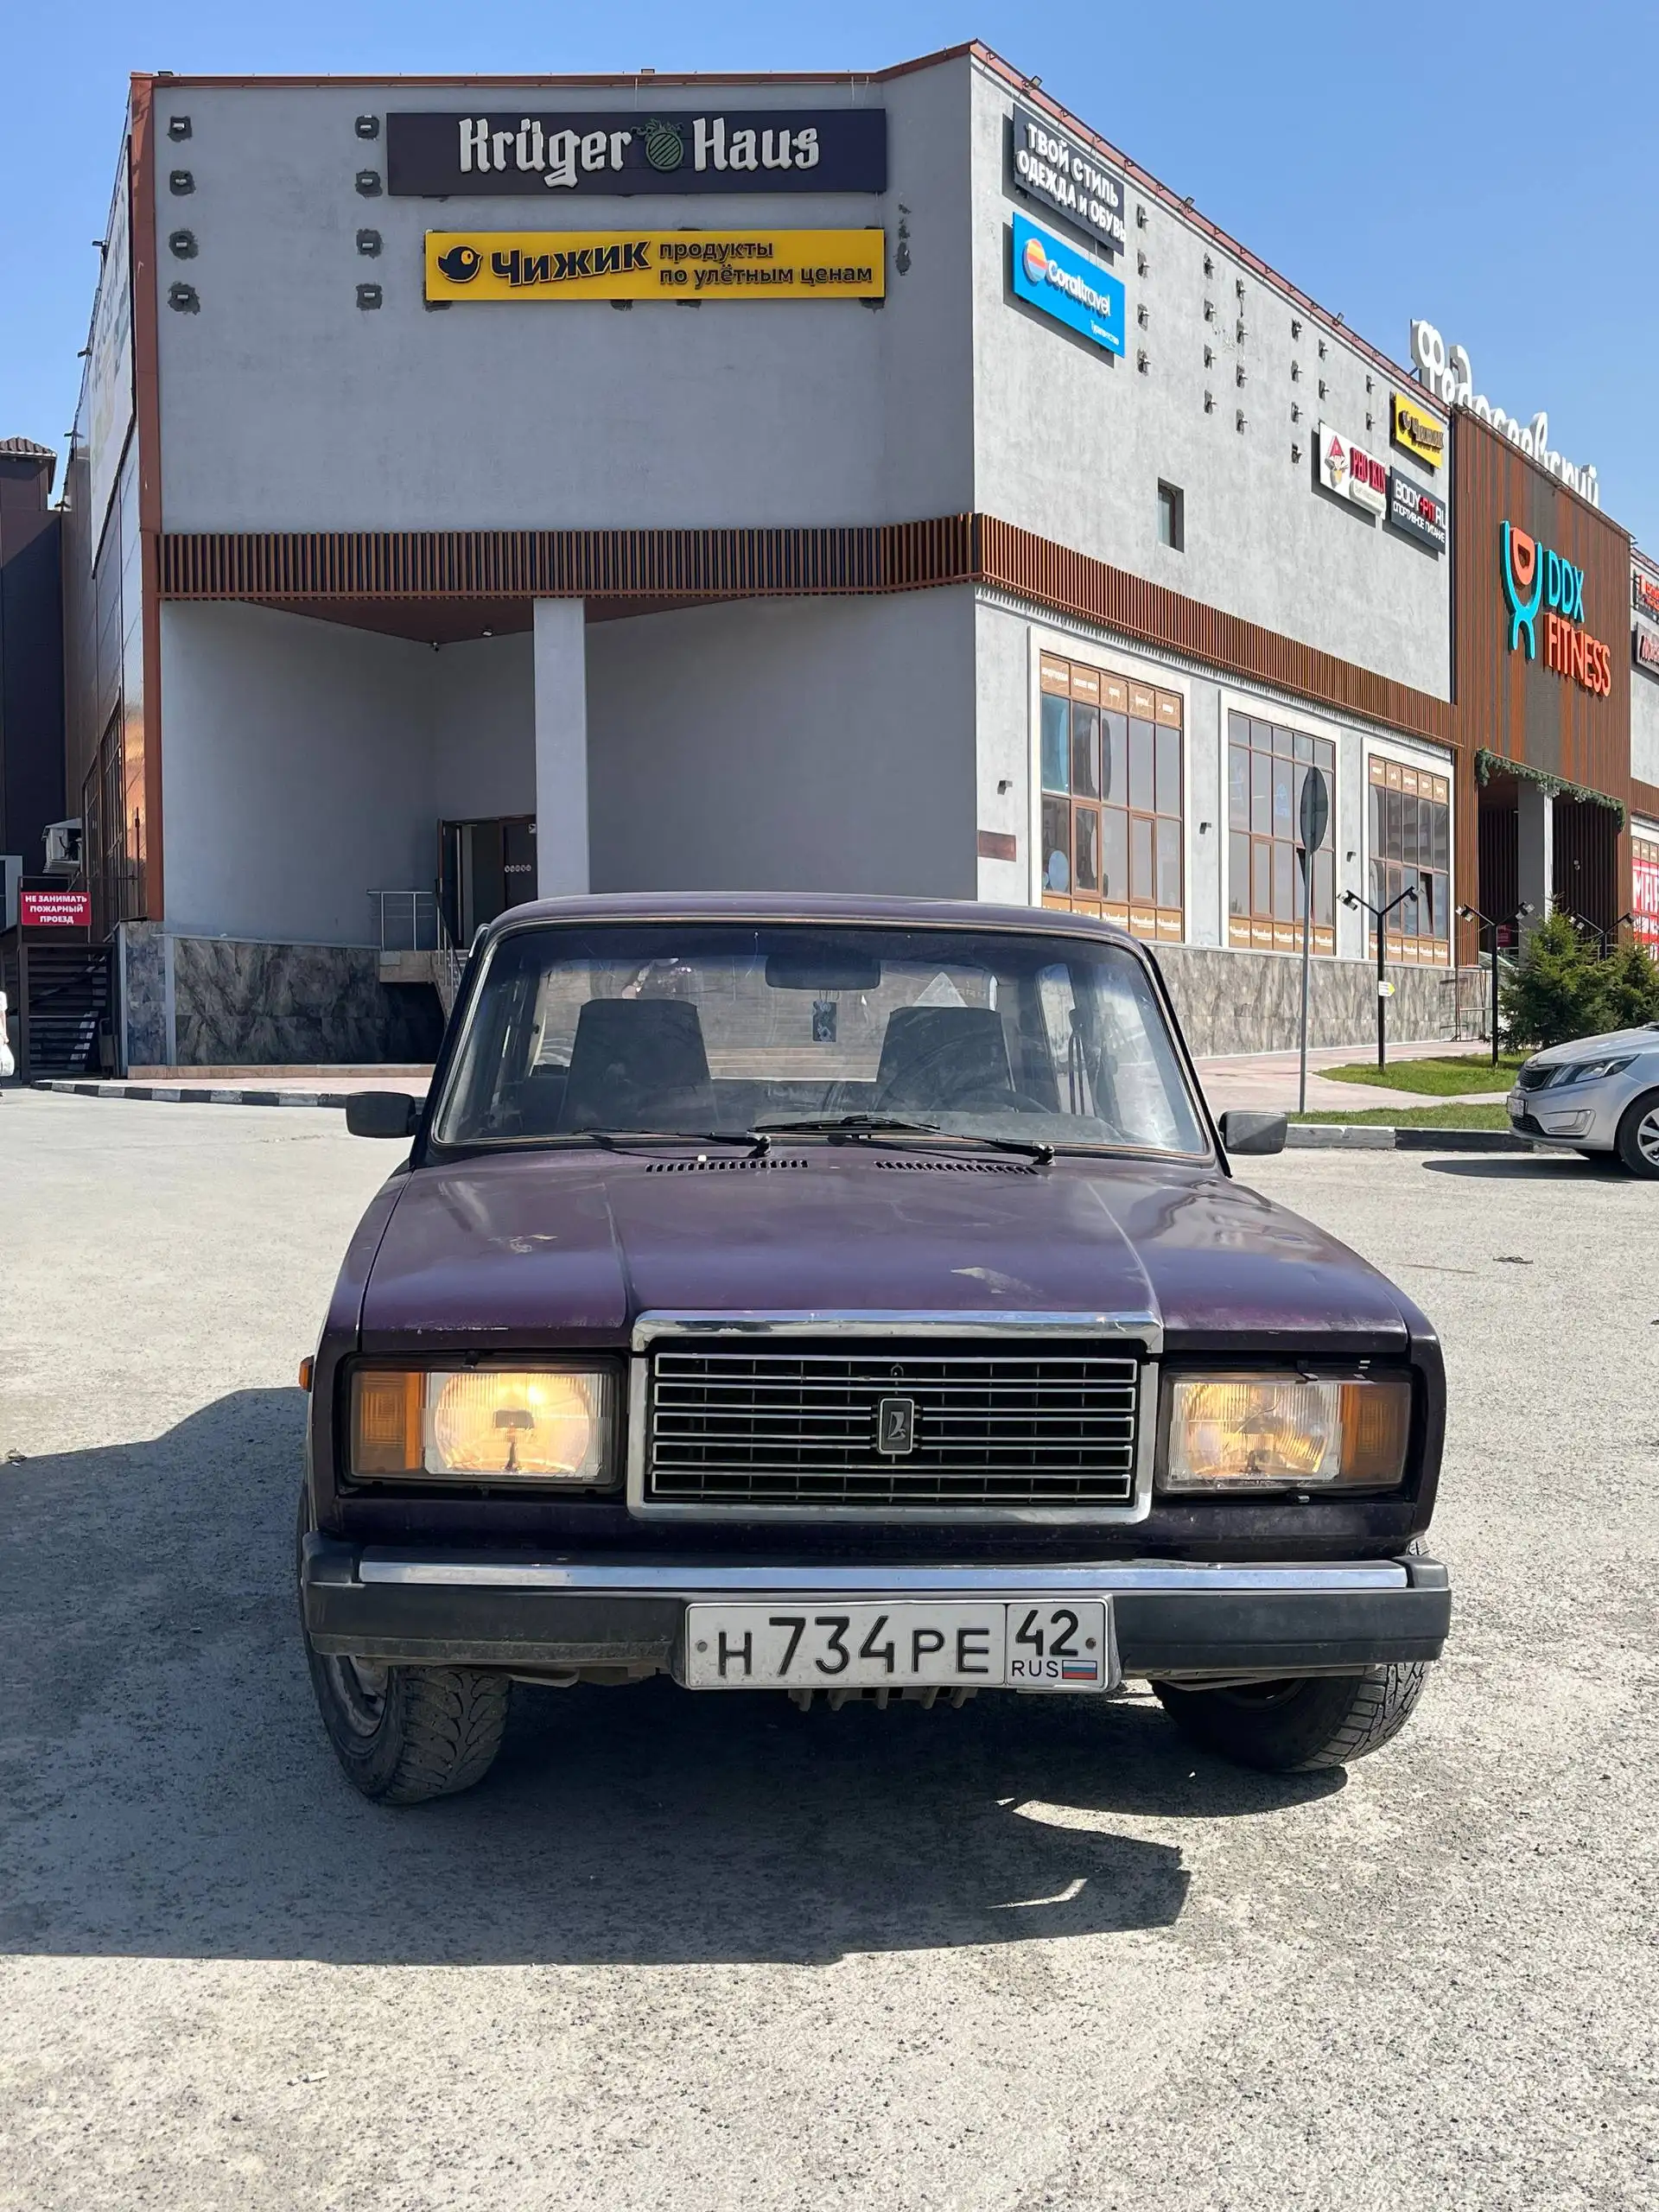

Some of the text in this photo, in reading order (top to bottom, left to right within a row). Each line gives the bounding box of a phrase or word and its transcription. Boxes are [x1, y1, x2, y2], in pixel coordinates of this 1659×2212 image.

[459, 118, 820, 188] Krüger Haus
[1026, 123, 1119, 208] ТВОЙ СТИЛЬ
[1016, 150, 1077, 210] ОДЕЖДА
[1088, 202, 1128, 244] ОБУВЬ
[490, 239, 652, 288] Чижик
[658, 240, 773, 260] продукты
[659, 264, 873, 288] по улётным ценам
[1350, 447, 1368, 483] PHO
[1544, 550, 1585, 623] DDX
[1545, 613, 1611, 696] FITNESS
[29, 904, 84, 913] ПОЖАРНЫЙ
[40, 915, 74, 925] ПРОЕЗД
[1014, 1609, 1079, 1657] 42
[1011, 1660, 1058, 1678] RUS
